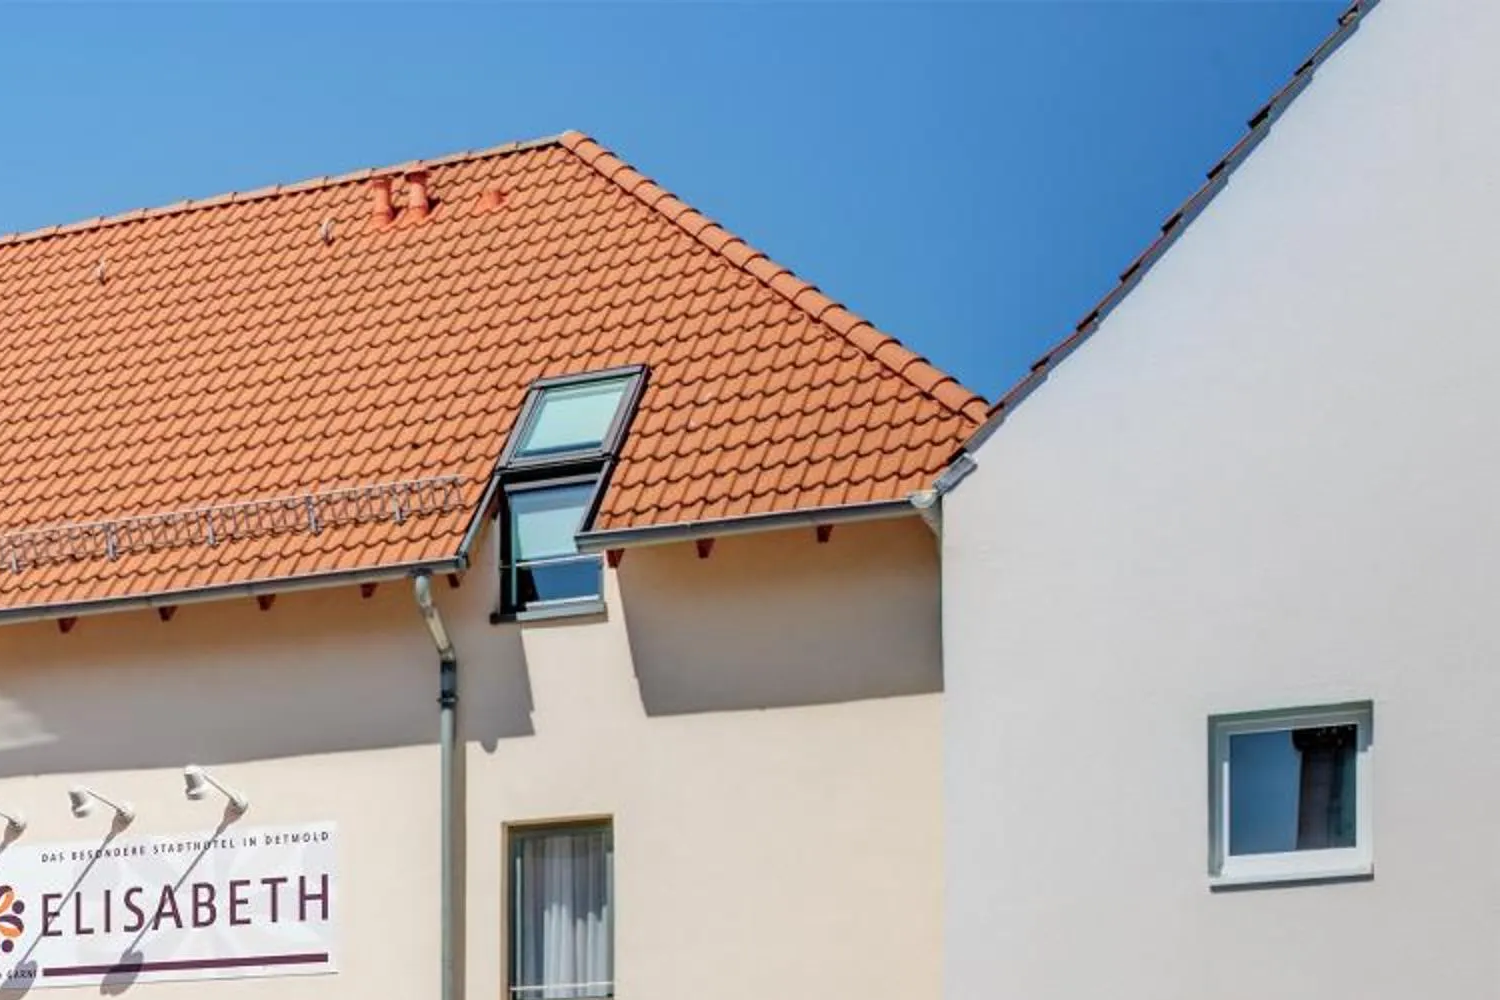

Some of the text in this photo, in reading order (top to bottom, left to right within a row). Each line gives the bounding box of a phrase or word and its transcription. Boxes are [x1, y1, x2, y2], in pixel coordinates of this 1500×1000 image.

[41, 831, 329, 863] DAS BESONDERE STADTHOTEL IN DETMOLD
[41, 874, 329, 937] ELISABETH
